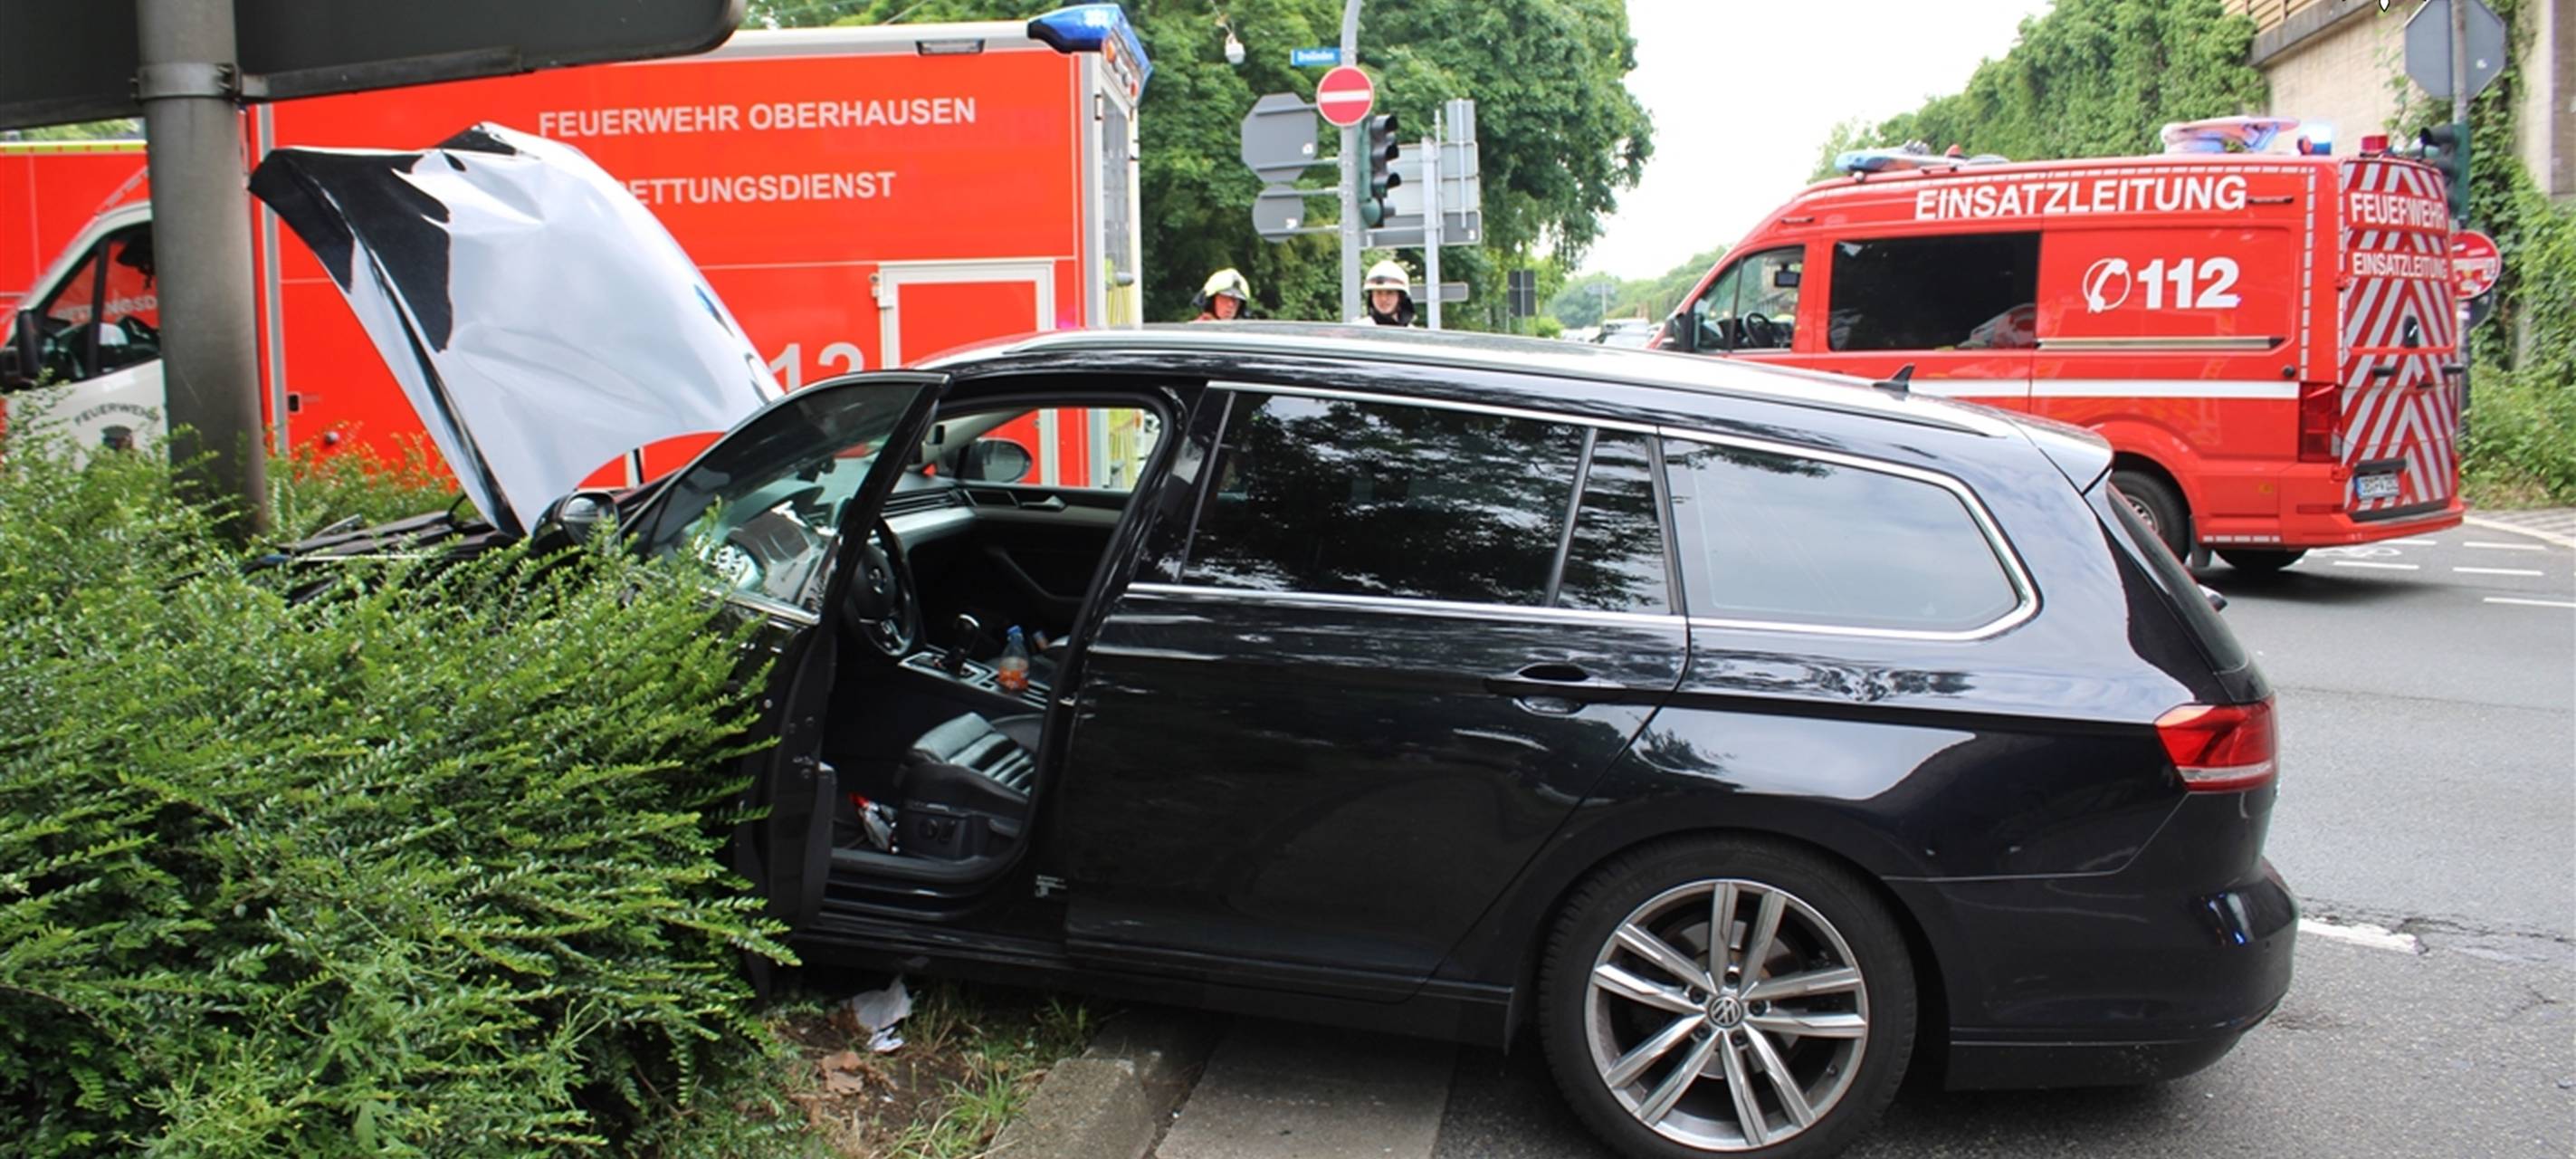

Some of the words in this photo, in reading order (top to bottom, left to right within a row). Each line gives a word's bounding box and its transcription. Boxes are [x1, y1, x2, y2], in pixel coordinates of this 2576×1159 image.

[539, 104, 740, 138] FEUERWEHR
[748, 96, 977, 131] OBERHAUSEN
[618, 170, 897, 206] ETTUNGSDIENST
[1913, 175, 2247, 221] EINSATZLEITUNG
[2350, 192, 2446, 229] FEUERWEHR
[2136, 256, 2241, 311] 112
[2352, 251, 2447, 280] EINSATZLEITUNG
